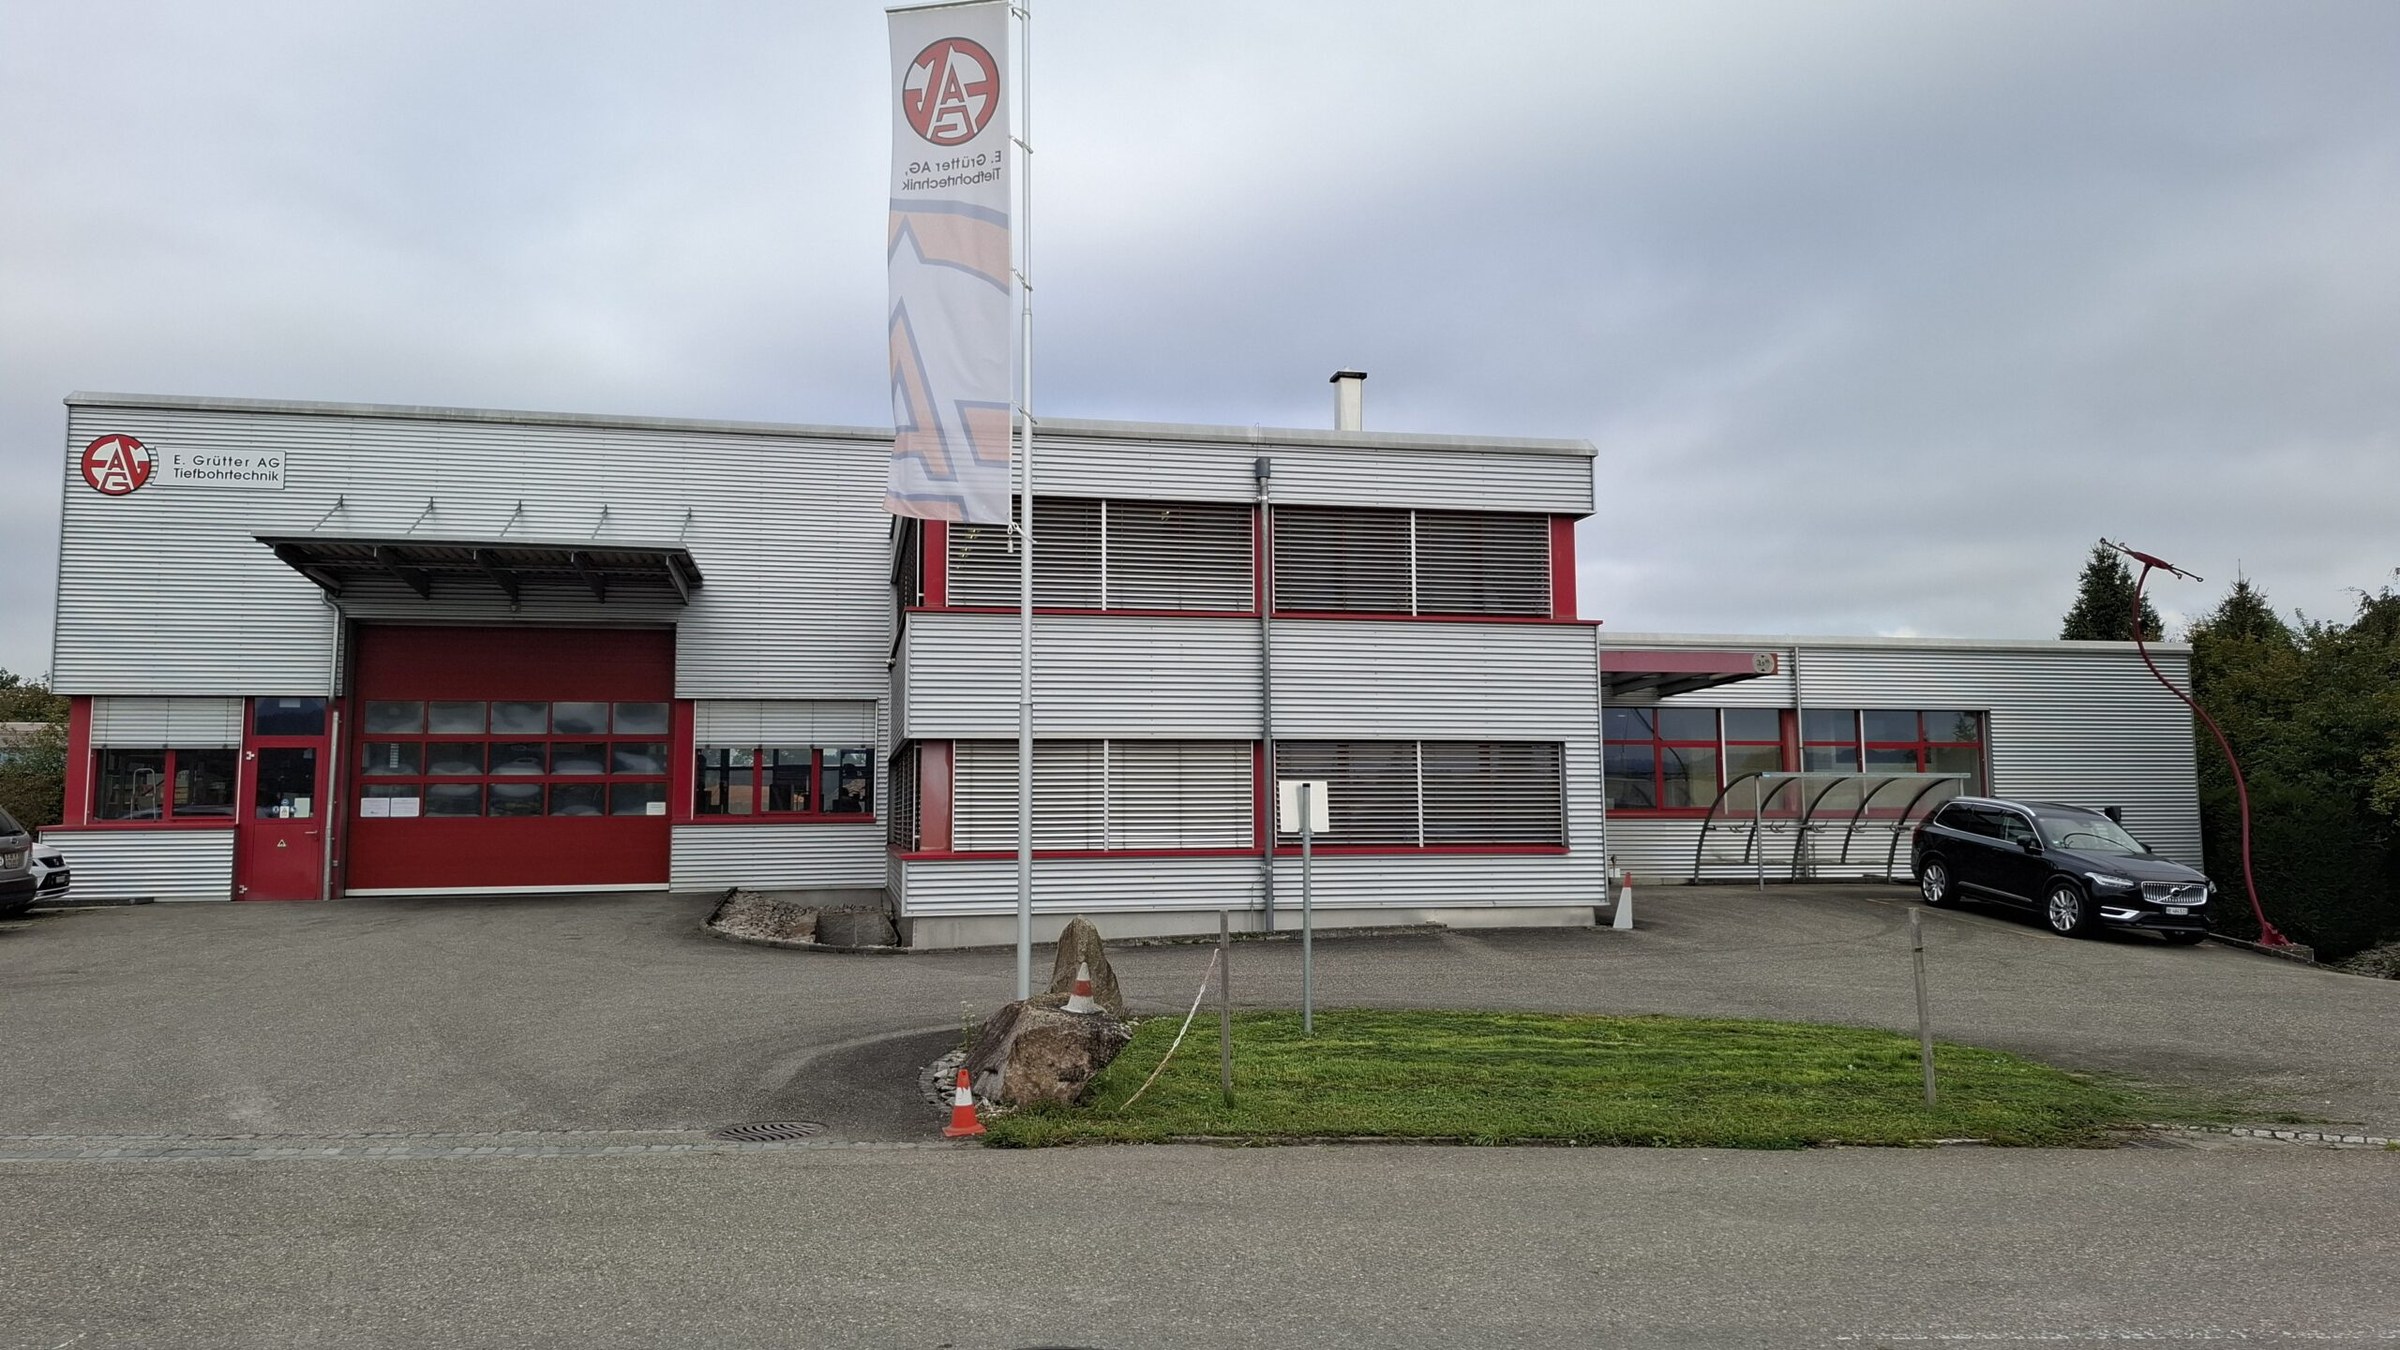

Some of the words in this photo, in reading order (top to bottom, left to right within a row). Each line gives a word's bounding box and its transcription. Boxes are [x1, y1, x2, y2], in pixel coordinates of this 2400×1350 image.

[173, 454, 186, 465] E.
[192, 454, 250, 467] Grütter
[257, 457, 280, 469] AG
[173, 467, 279, 481] Tiefbohrtechnik
